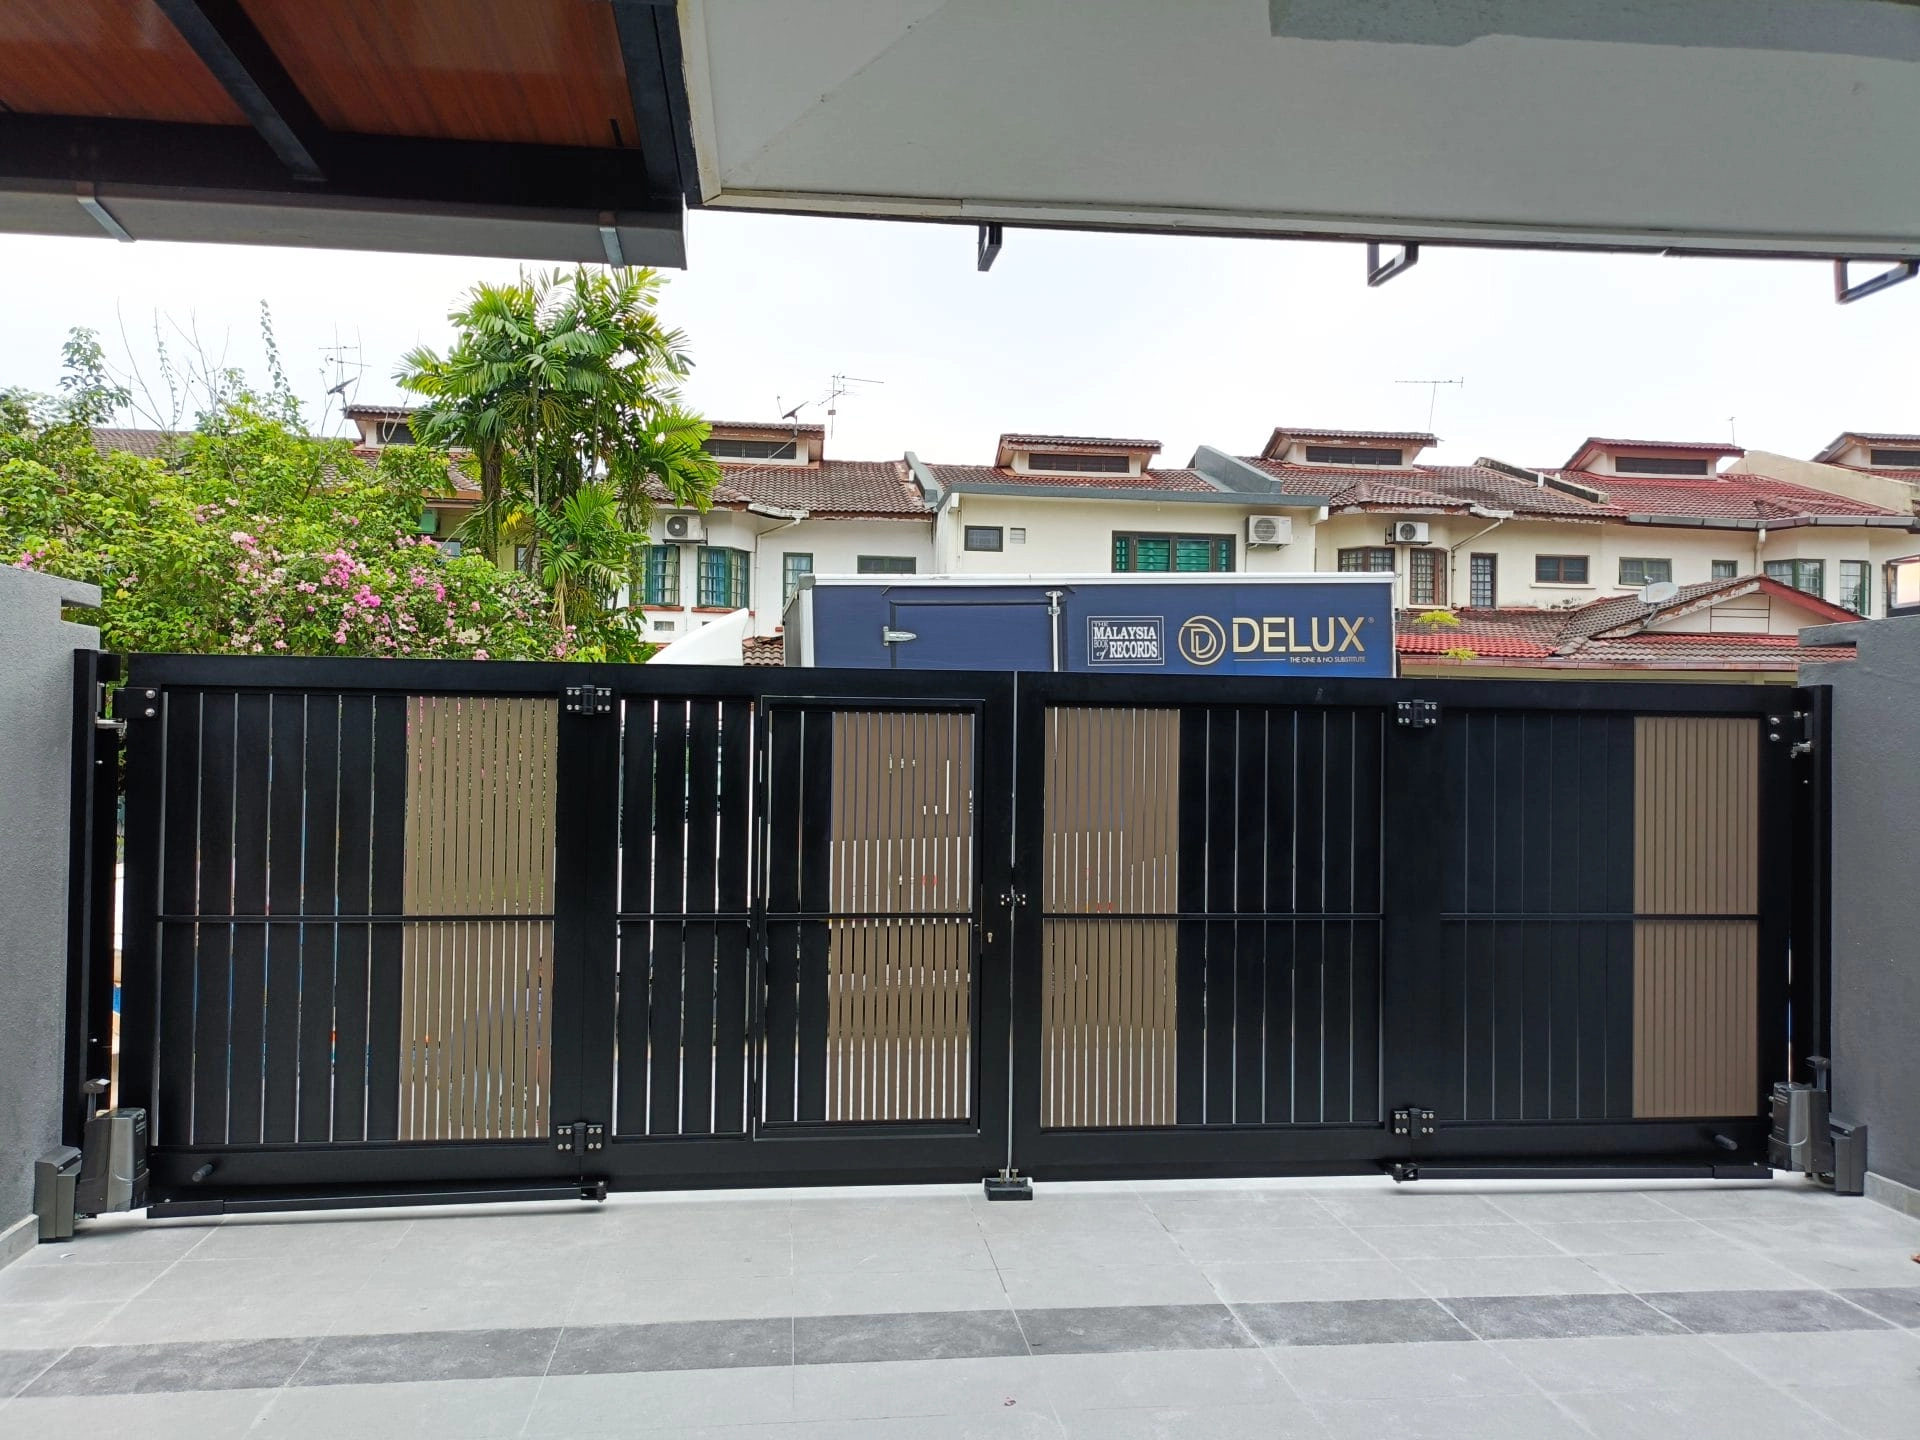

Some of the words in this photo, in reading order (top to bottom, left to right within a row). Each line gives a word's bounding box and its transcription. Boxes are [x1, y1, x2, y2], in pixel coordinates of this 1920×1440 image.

[1093, 626, 1157, 640] MALAYSIA
[1232, 617, 1365, 652] DELUX
[1093, 639, 1109, 648] BOOK
[1109, 641, 1158, 658] RECORDS
